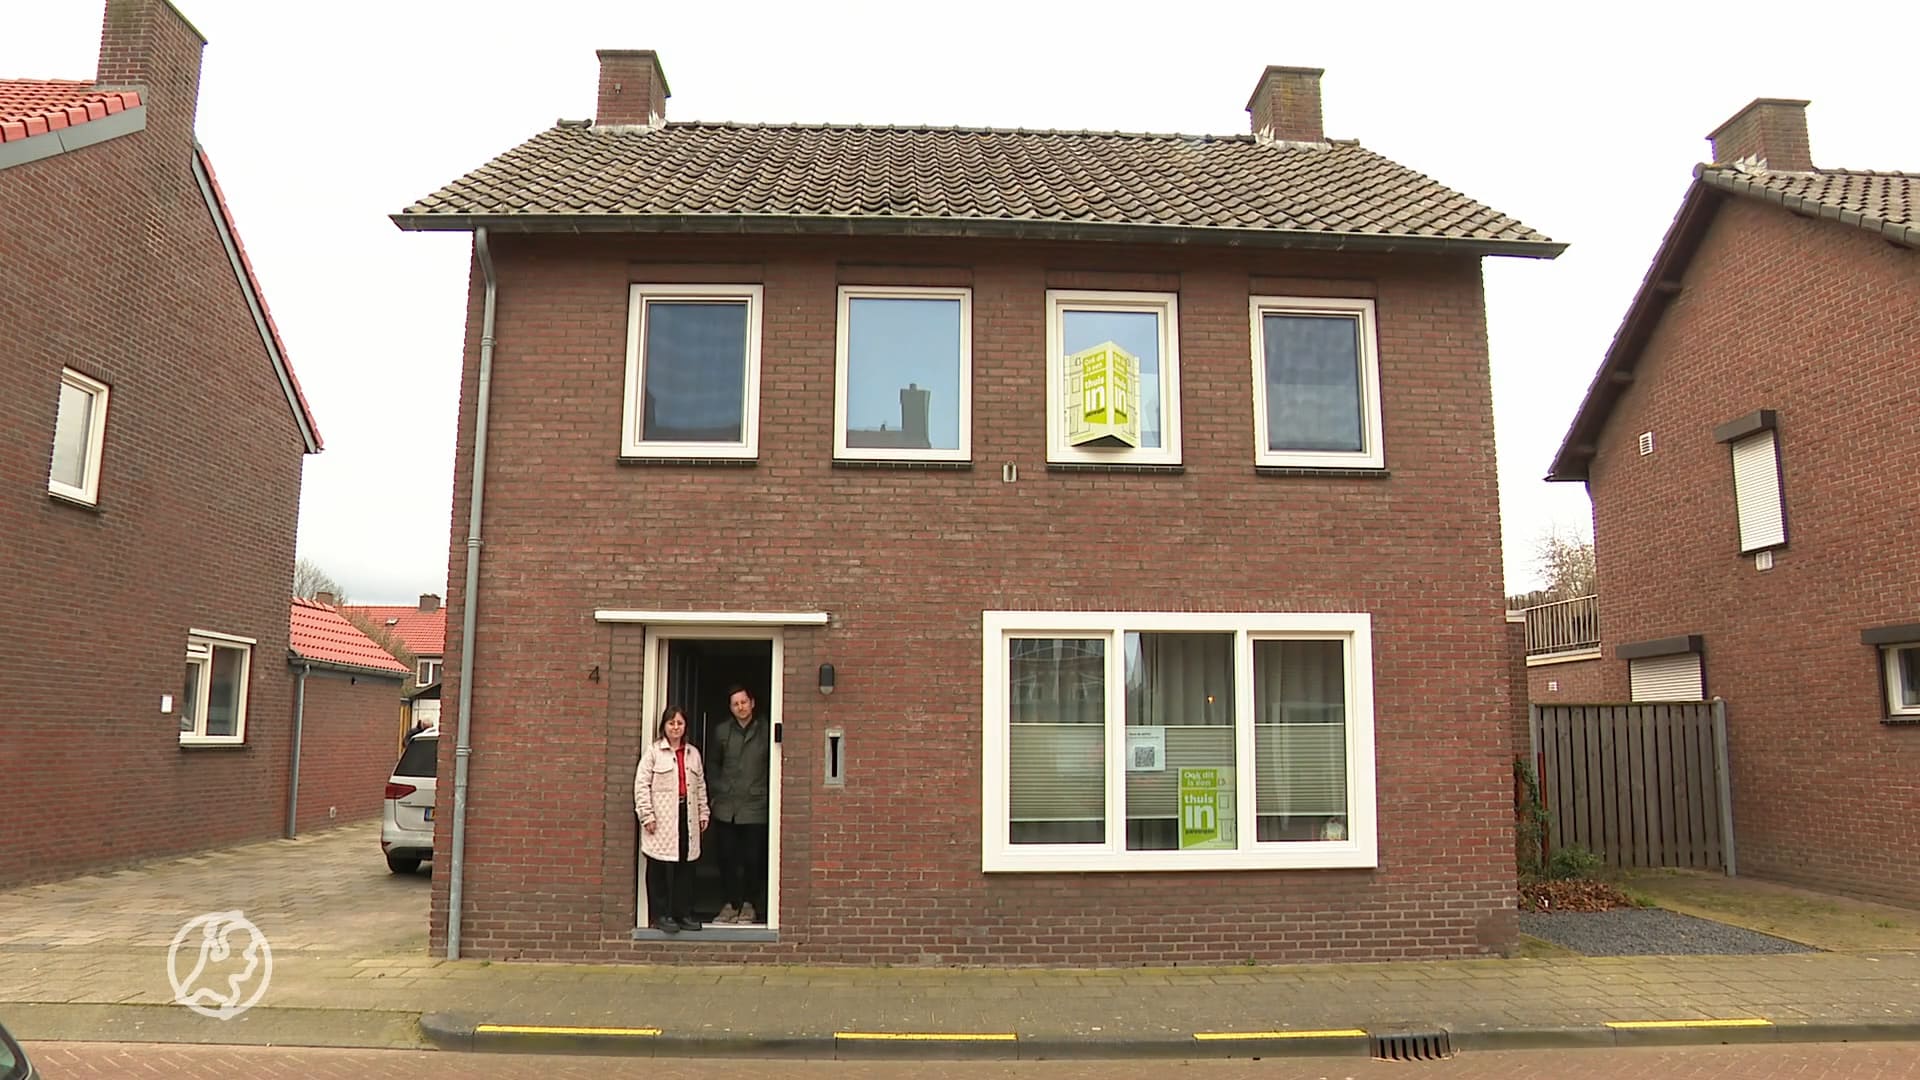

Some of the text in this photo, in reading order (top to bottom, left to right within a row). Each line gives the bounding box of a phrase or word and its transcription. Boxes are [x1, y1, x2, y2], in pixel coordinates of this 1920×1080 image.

[1085, 386, 1105, 414] in
[1184, 771, 1214, 779] Ook dit
[1184, 793, 1214, 804] thuis
[1185, 804, 1215, 829] in
